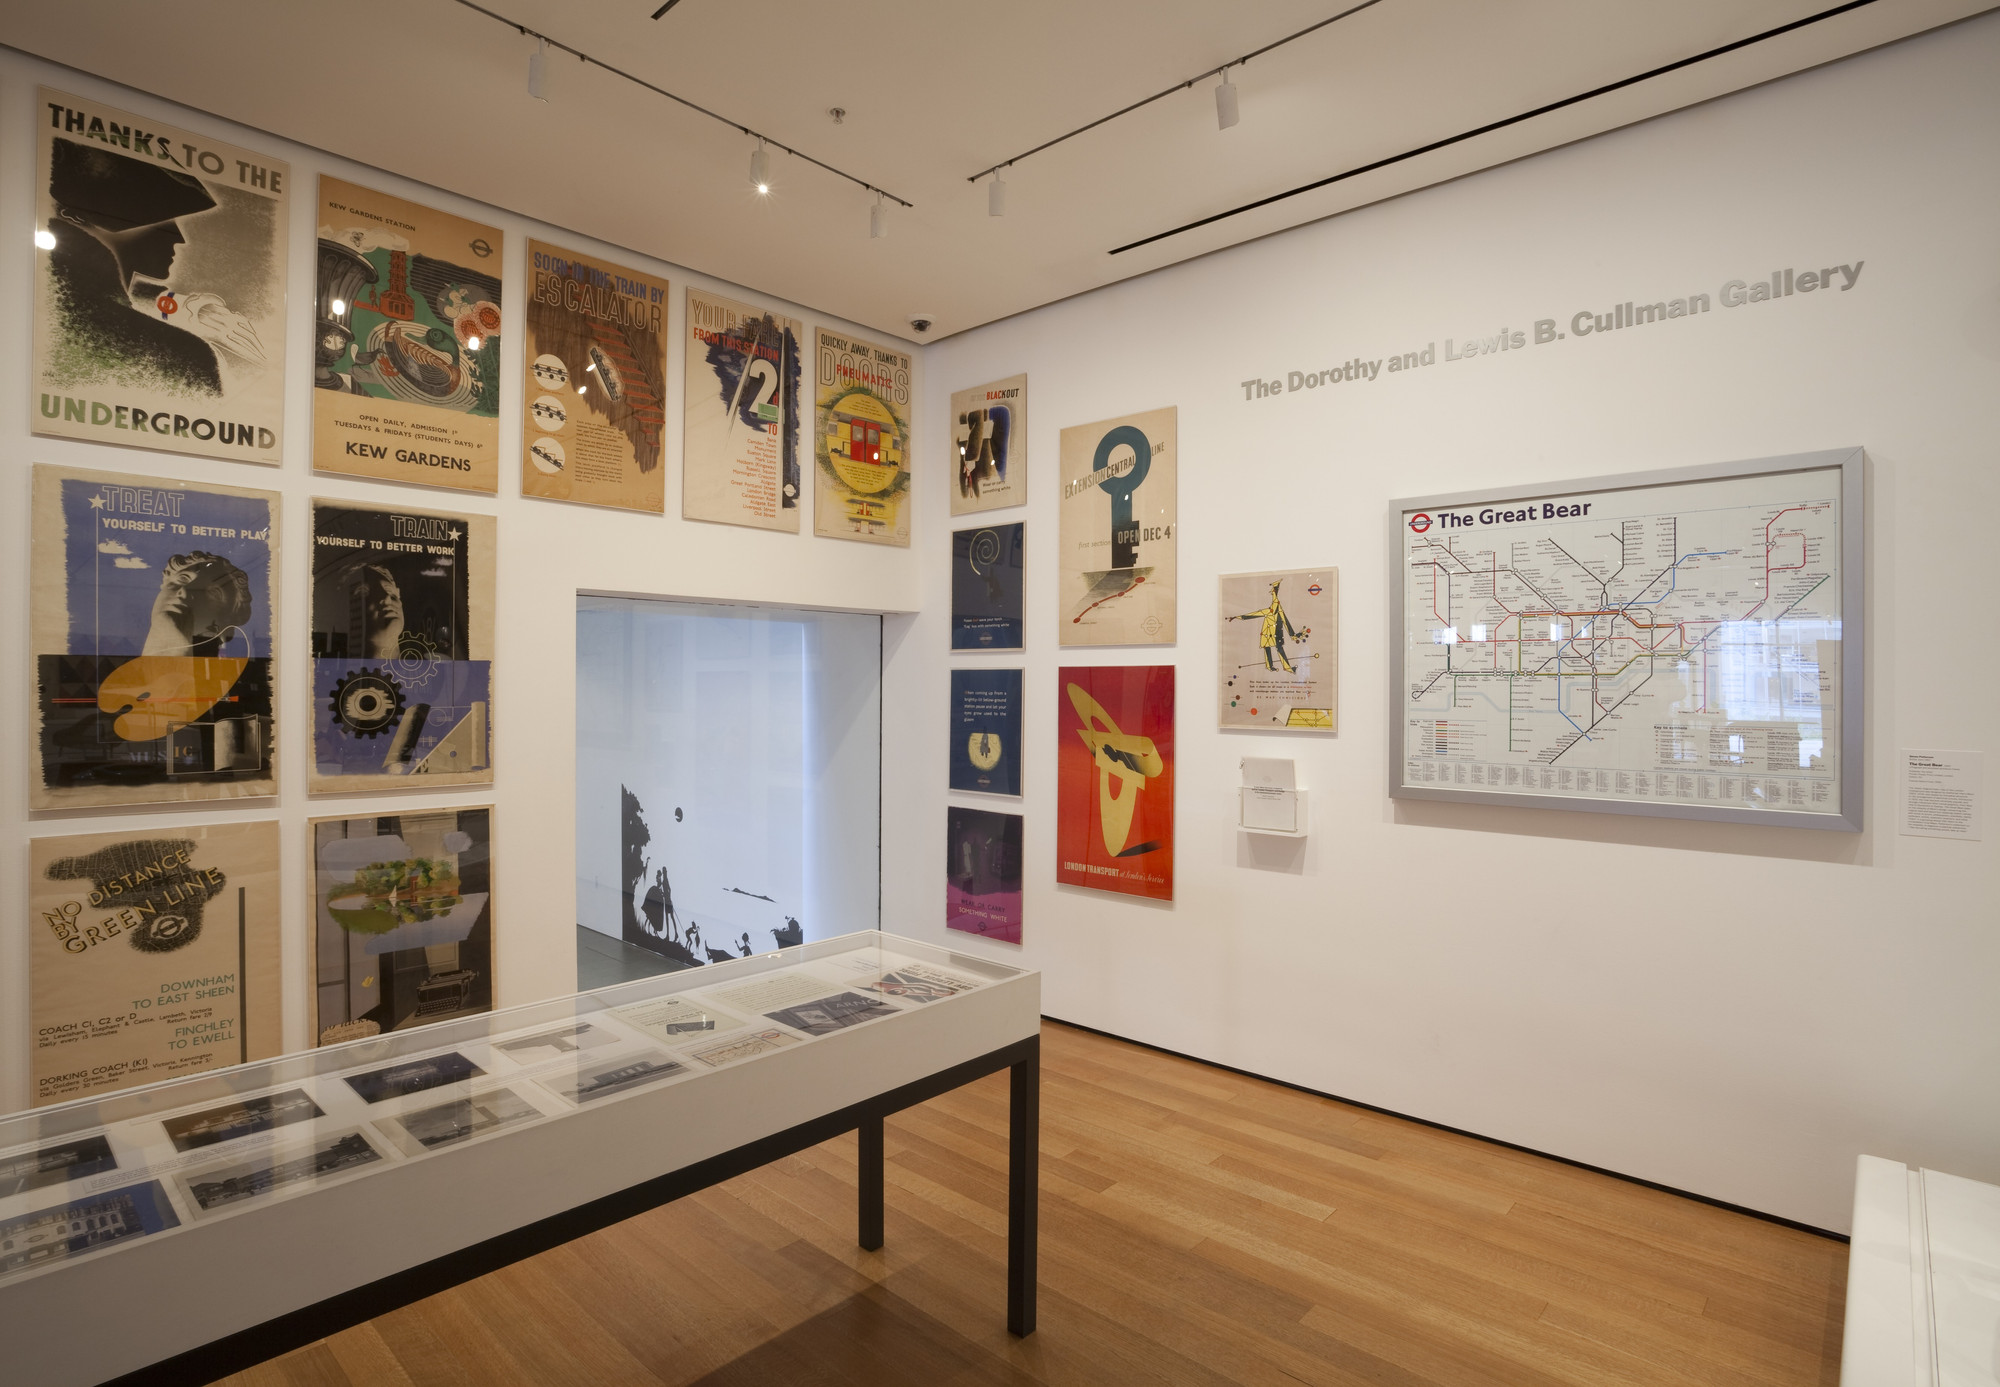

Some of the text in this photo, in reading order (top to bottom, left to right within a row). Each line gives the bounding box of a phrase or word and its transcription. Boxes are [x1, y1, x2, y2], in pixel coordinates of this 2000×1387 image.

[48, 103, 282, 194] THANKS TO THE
[329, 201, 416, 232] KEW GARDENS STATION
[534, 251, 664, 304] SOON IN THE TRAIN BY
[534, 271, 662, 334] ESCALATOR
[692, 299, 736, 331] YOUR
[1241, 260, 1864, 400] The Dorothy and Lewis B. Cullman Gallery
[693, 327, 779, 362] FROM THIS STATION
[821, 333, 848, 351] QUICKLY
[874, 349, 897, 367] THANKS
[900, 358, 908, 369] TO
[820, 346, 909, 405] DOORS
[836, 364, 893, 389] PNEUMATIC
[986, 388, 1019, 400] BLACKOUT
[40, 393, 275, 450] UNDERGROUND
[334, 419, 372, 434] TUESDAYS
[383, 428, 412, 439] FRIDAYS
[454, 437, 474, 449] DAYS)
[359, 414, 448, 434] OPEN DAILY, ADMISSION
[768, 422, 777, 435] TO
[346, 441, 472, 472] KEW GARDENS
[1065, 442, 1165, 500] EXTENSION CENTRAL LINE
[102, 486, 184, 517] TREAT
[102, 517, 165, 533] YOURSELF
[171, 523, 186, 534] TO
[192, 525, 236, 539] BETTER
[1438, 503, 1591, 528] The Great Bear
[391, 516, 450, 541] TRAIN
[1117, 526, 1171, 544] OPEN DEC 4
[316, 536, 454, 556] YOURSELF TO BETTER WORK
[1064, 861, 1086, 872] LONDON
[1086, 864, 1120, 877] TRANSPORT
[42, 849, 191, 927] NO DISTANCE
[50, 866, 225, 954] BY GREEN LINE
[959, 907, 1007, 923] SOMETHING WHITE
[161, 973, 234, 994] DOWNHAM
[132, 985, 234, 1010] TO EAST SHEEN
[39, 1023, 78, 1036] COACH
[98, 1017, 111, 1025] C2
[129, 1012, 137, 1020] D
[92, 1022, 120, 1034] Elephant
[175, 1018, 234, 1038] FINCHLEY
[39, 1040, 57, 1048] Daily
[59, 1036, 79, 1044] every
[92, 1029, 118, 1038] minutes
[167, 1030, 235, 1051] TO EWELL
[40, 1069, 88, 1087] DORKING
[92, 1062, 128, 1075] COACH
